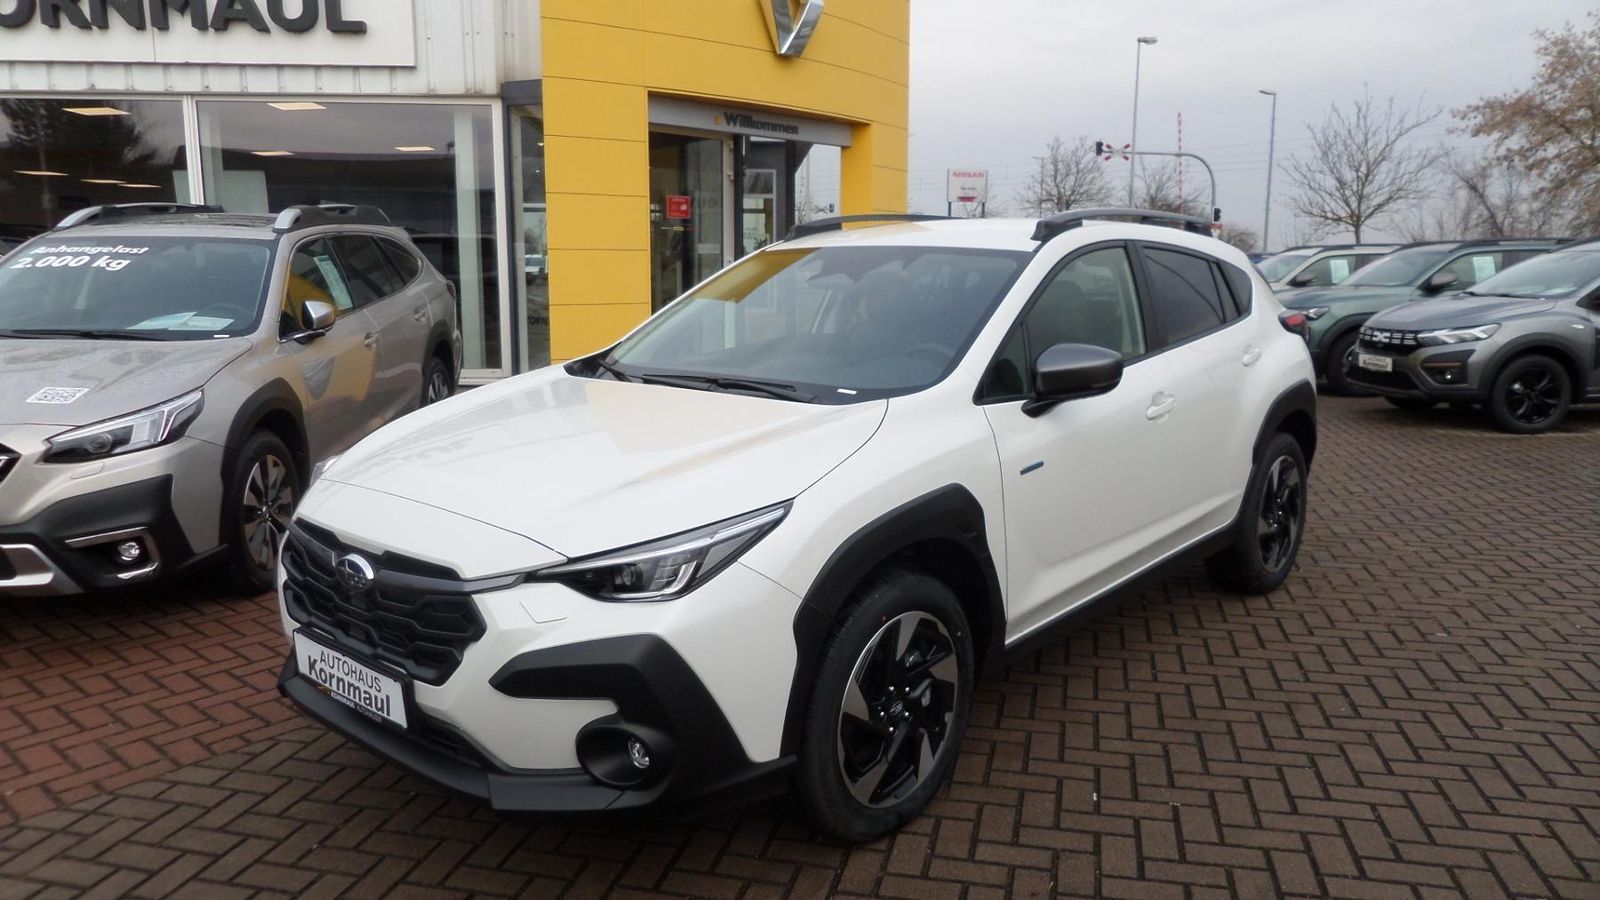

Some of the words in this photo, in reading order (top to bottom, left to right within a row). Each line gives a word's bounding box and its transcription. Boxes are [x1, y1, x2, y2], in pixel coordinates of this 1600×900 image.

[723, 111, 799, 135] Willkommen
[9, 256, 91, 269] 2.000
[91, 256, 132, 271] kg
[307, 655, 391, 717] Kornmaul
[320, 650, 382, 693] AUTOHAUS
